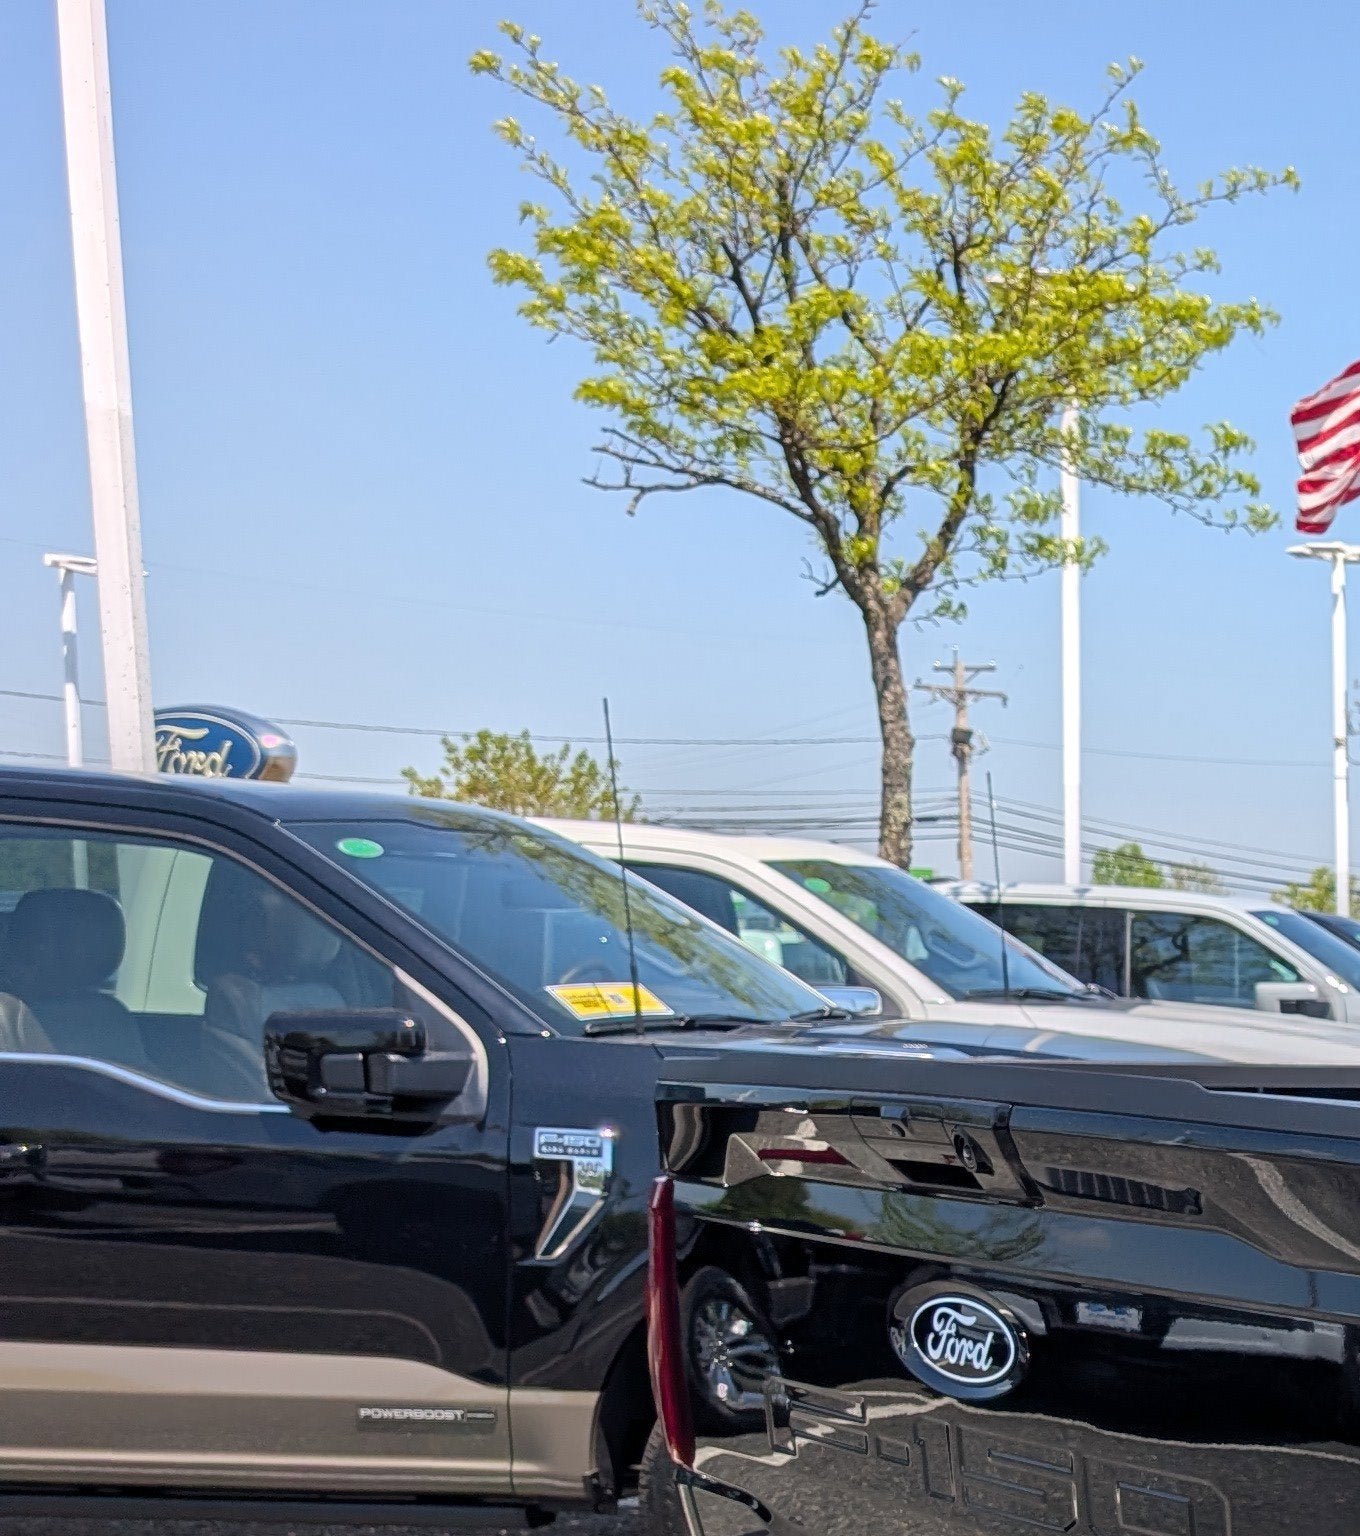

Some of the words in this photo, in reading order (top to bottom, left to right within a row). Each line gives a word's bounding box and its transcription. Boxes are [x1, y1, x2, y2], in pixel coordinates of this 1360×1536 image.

[154, 724, 234, 778] Ford
[927, 1306, 995, 1371] Ford
[359, 1407, 465, 1421] POWERBOOST
